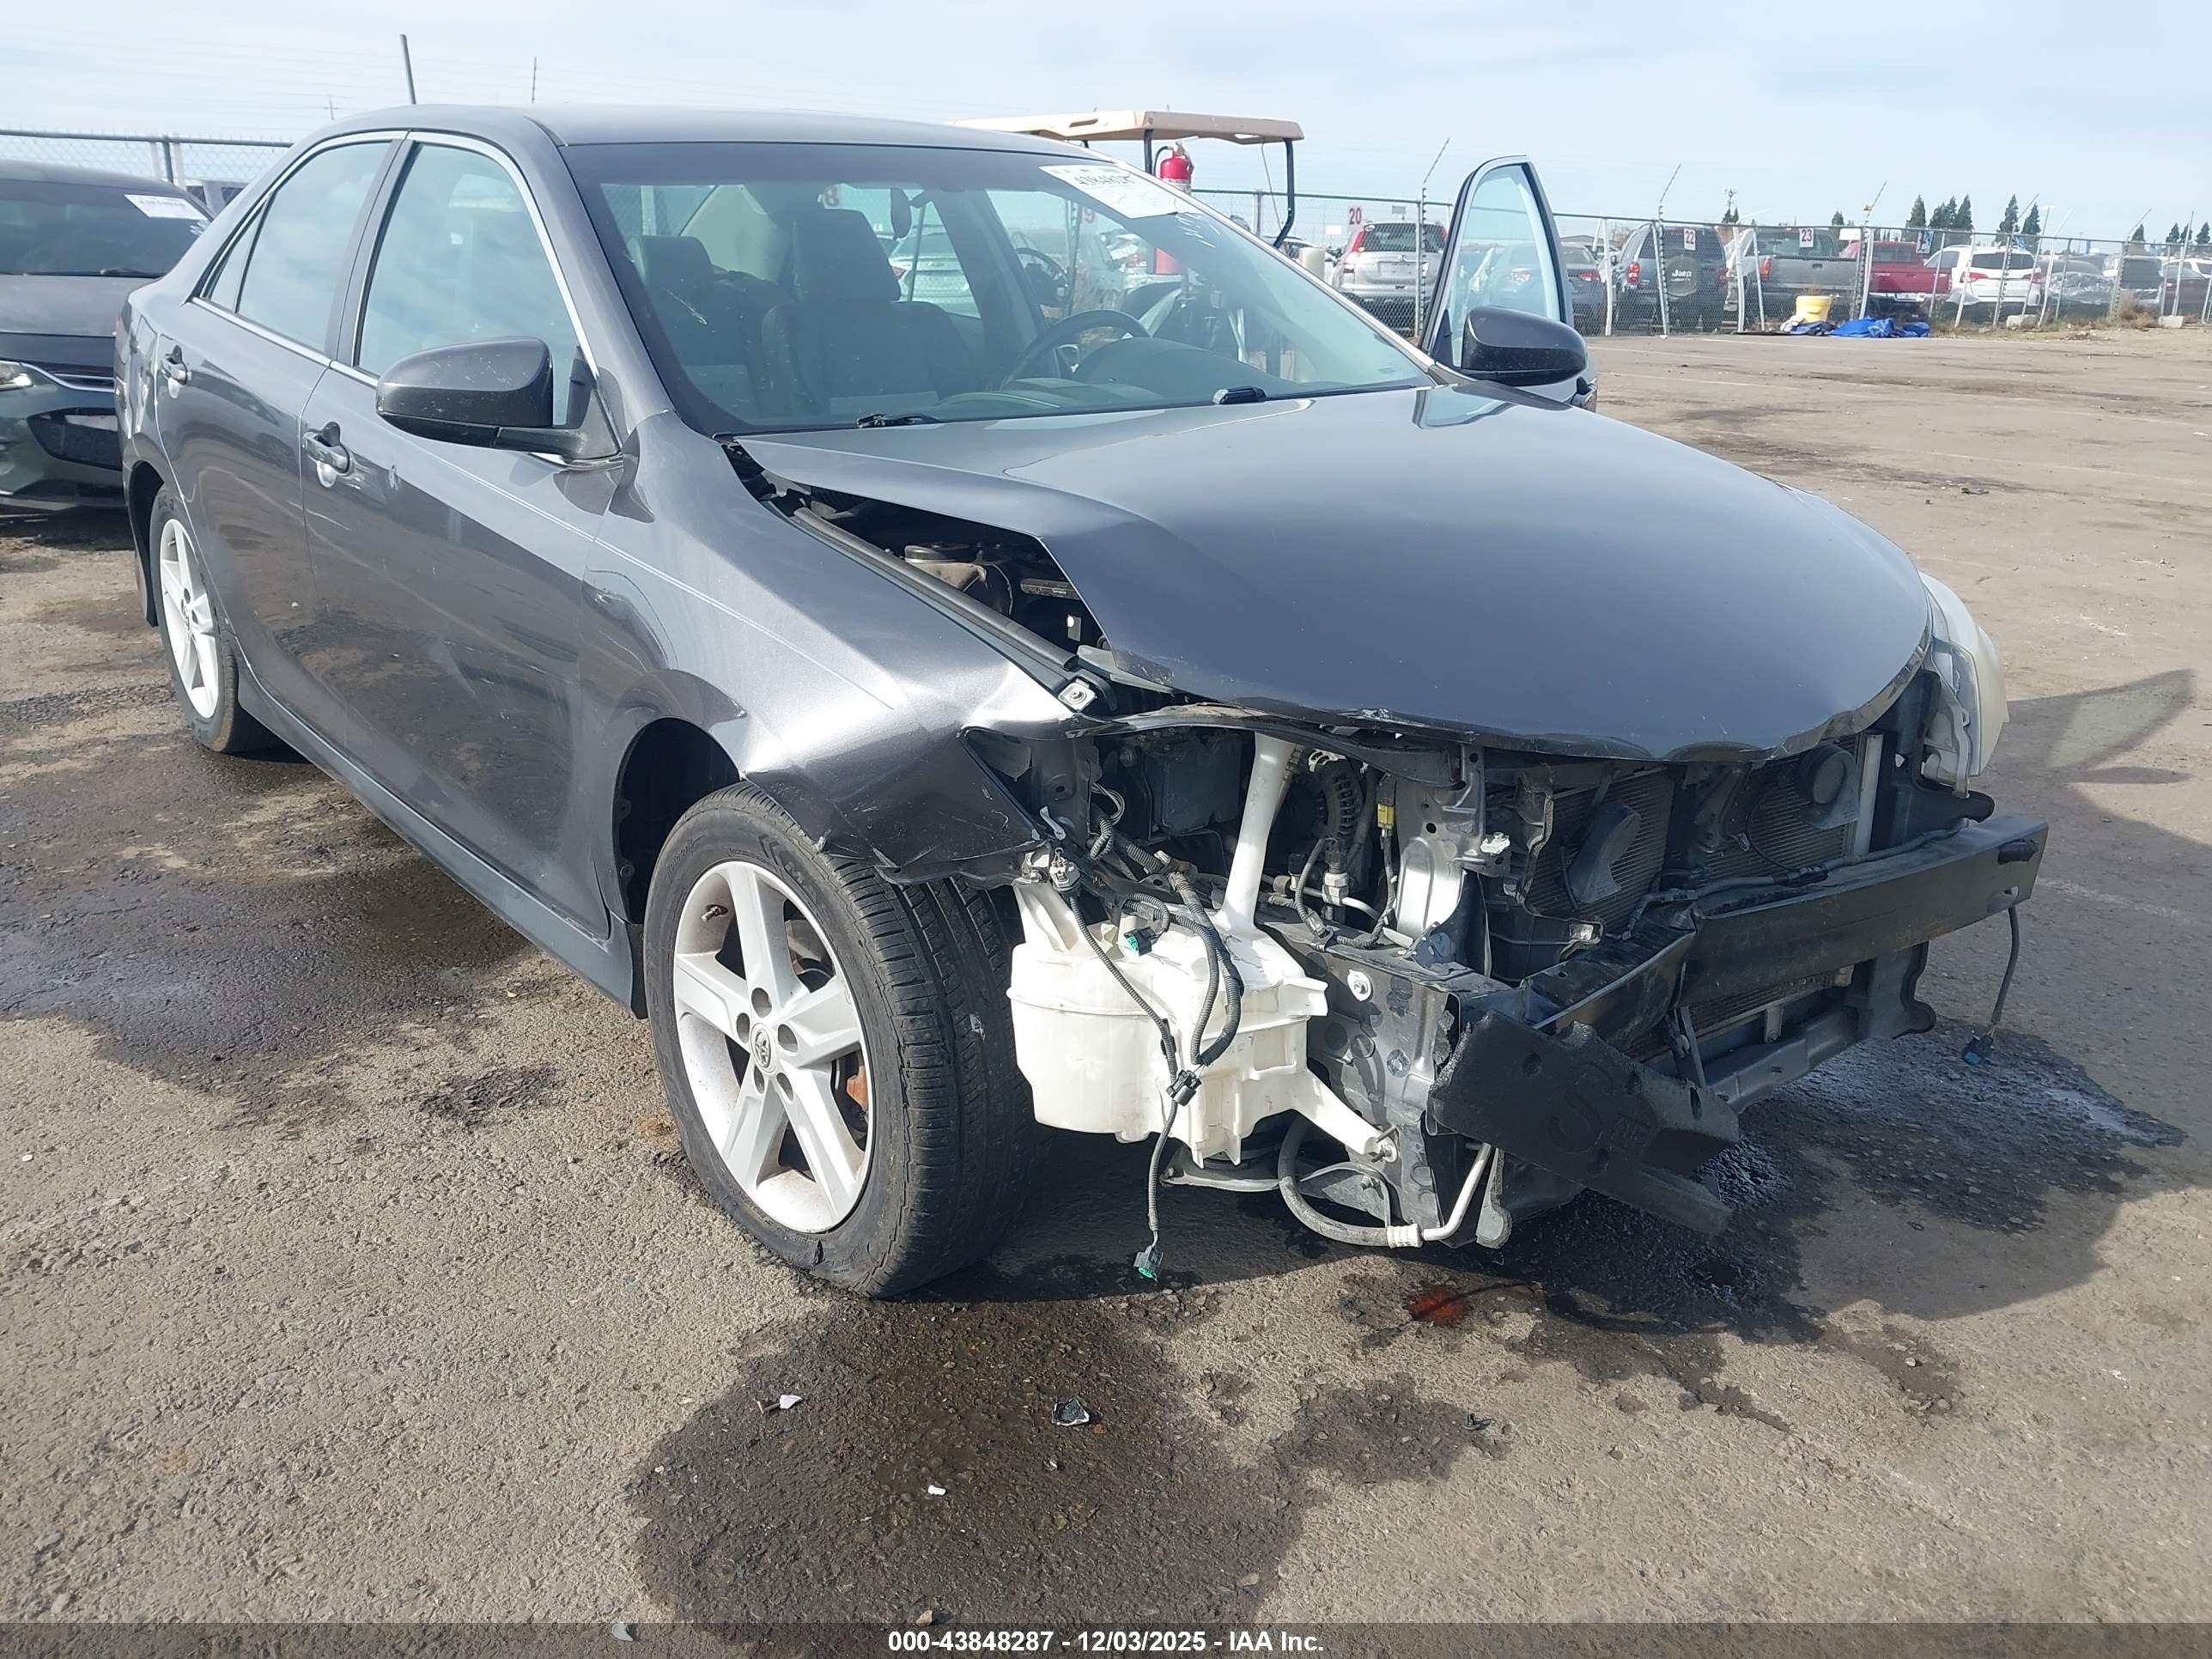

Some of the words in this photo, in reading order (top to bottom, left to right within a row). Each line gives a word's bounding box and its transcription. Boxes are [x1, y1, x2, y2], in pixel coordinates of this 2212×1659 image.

[1349, 207, 1362, 225] 20
[1686, 230, 1695, 245] 22
[1801, 228, 1812, 242] 23
